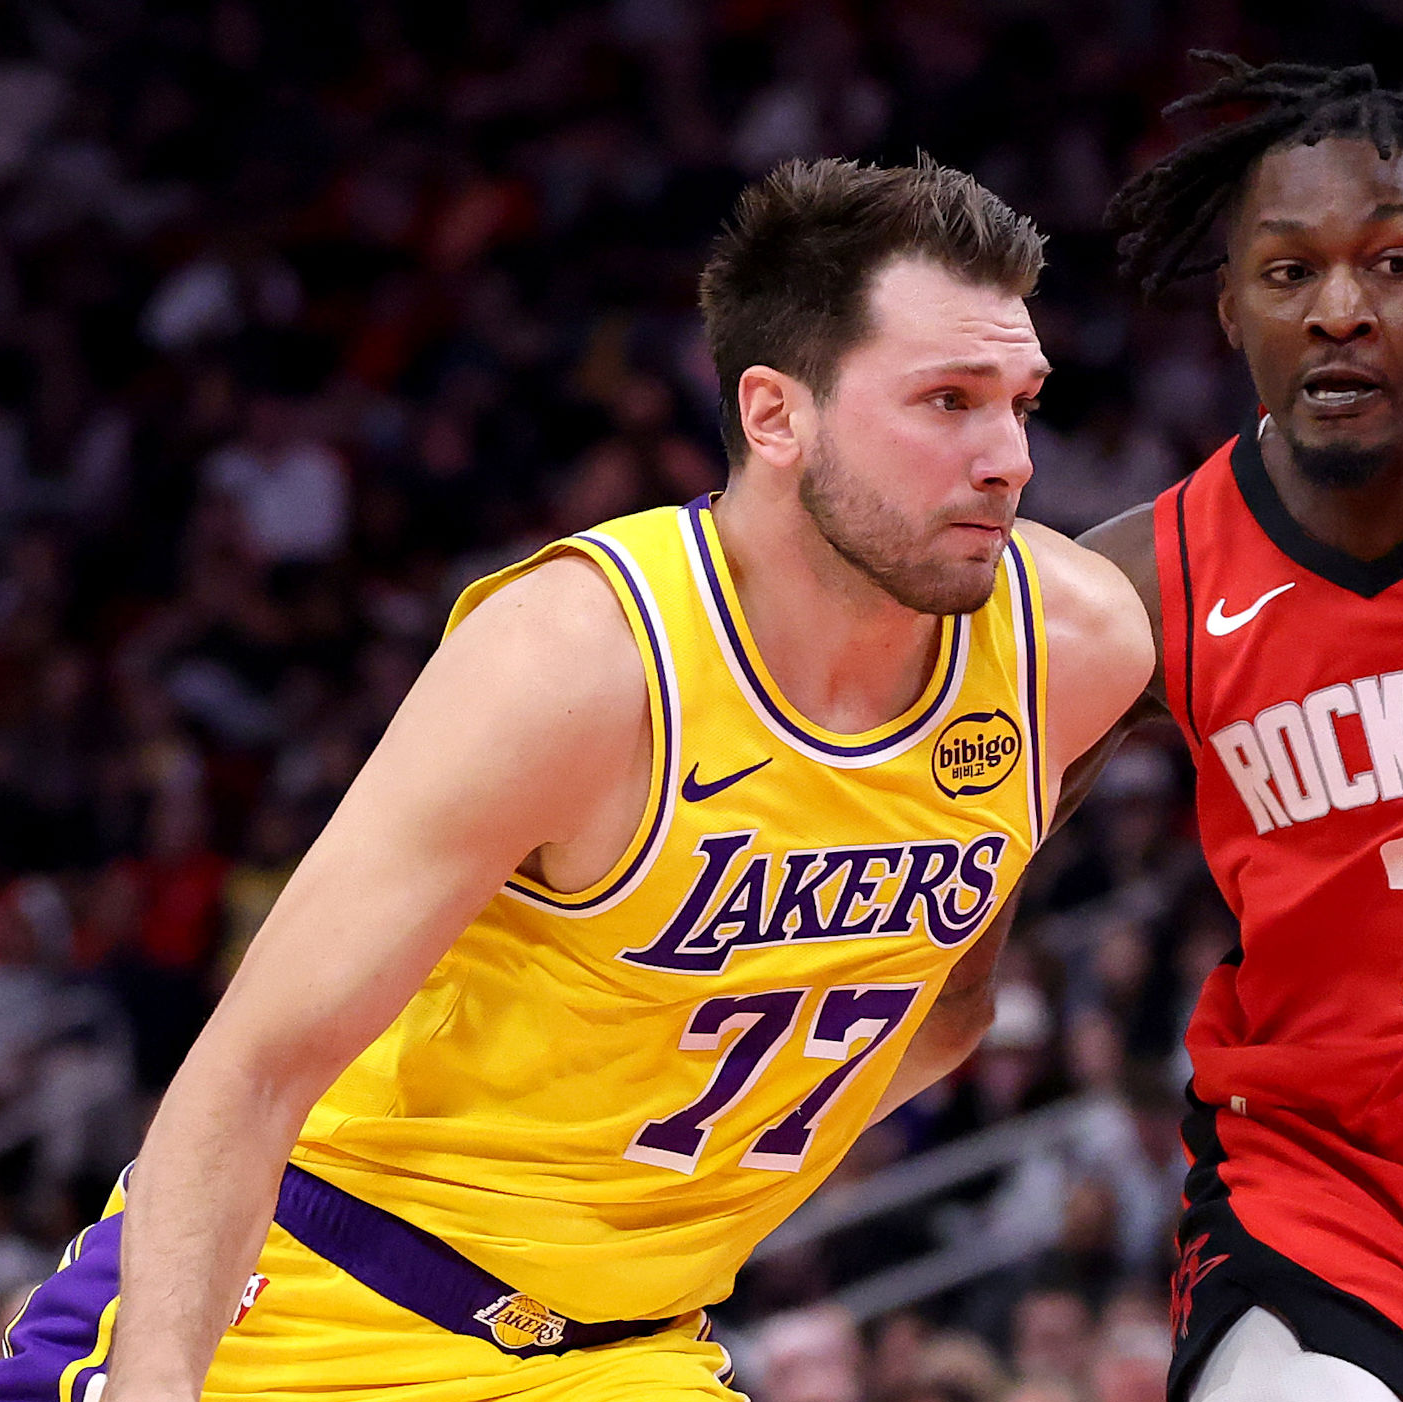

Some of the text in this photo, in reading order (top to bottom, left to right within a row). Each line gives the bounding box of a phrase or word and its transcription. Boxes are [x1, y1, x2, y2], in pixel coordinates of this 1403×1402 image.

[939, 733, 1016, 769] bibigo
[951, 762, 985, 780] 비비고
[614, 828, 1011, 976] LAKERS
[622, 980, 926, 1175] 77
[483, 1300, 562, 1346] LAKERS
